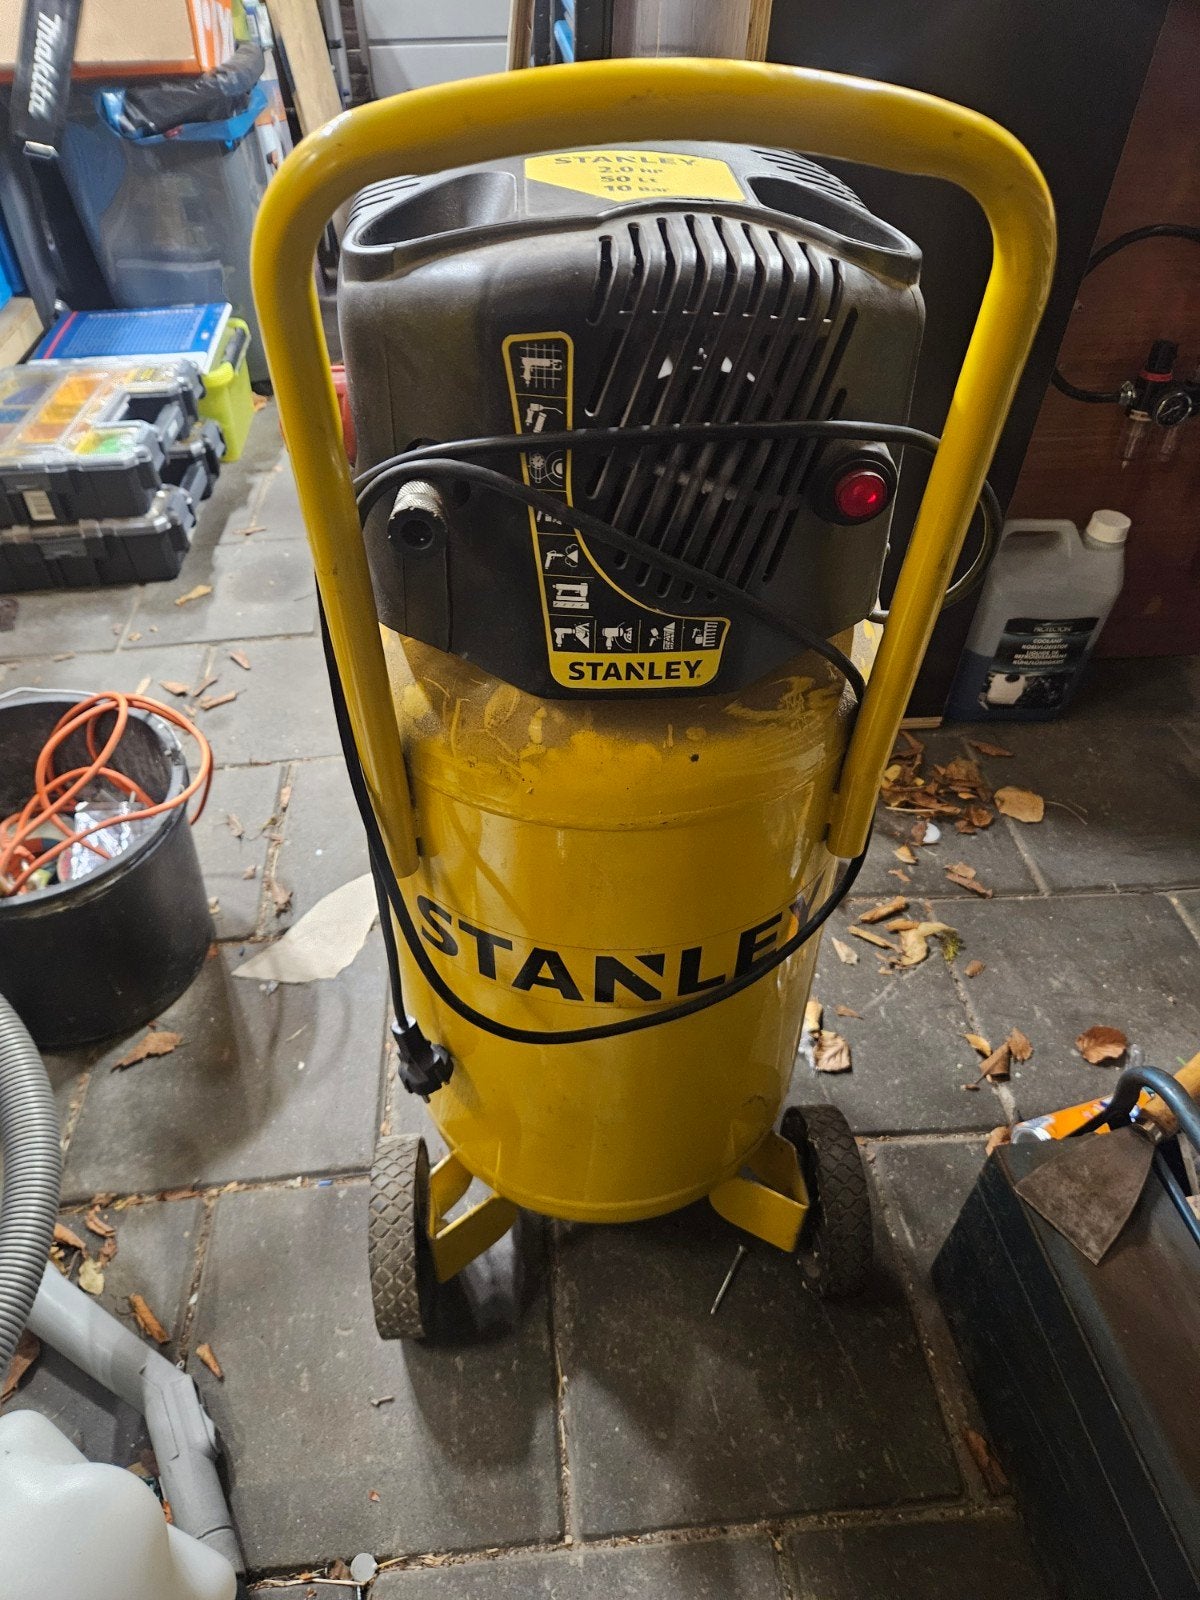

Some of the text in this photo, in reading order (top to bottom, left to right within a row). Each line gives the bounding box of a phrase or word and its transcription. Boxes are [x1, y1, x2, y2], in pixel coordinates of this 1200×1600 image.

[555, 156, 696, 165] STANLEY
[598, 165, 634, 173] 2.0
[599, 175, 631, 183] 50
[603, 184, 632, 192] 10
[568, 660, 703, 681] STANLEY
[417, 869, 826, 1003] STANLEY
